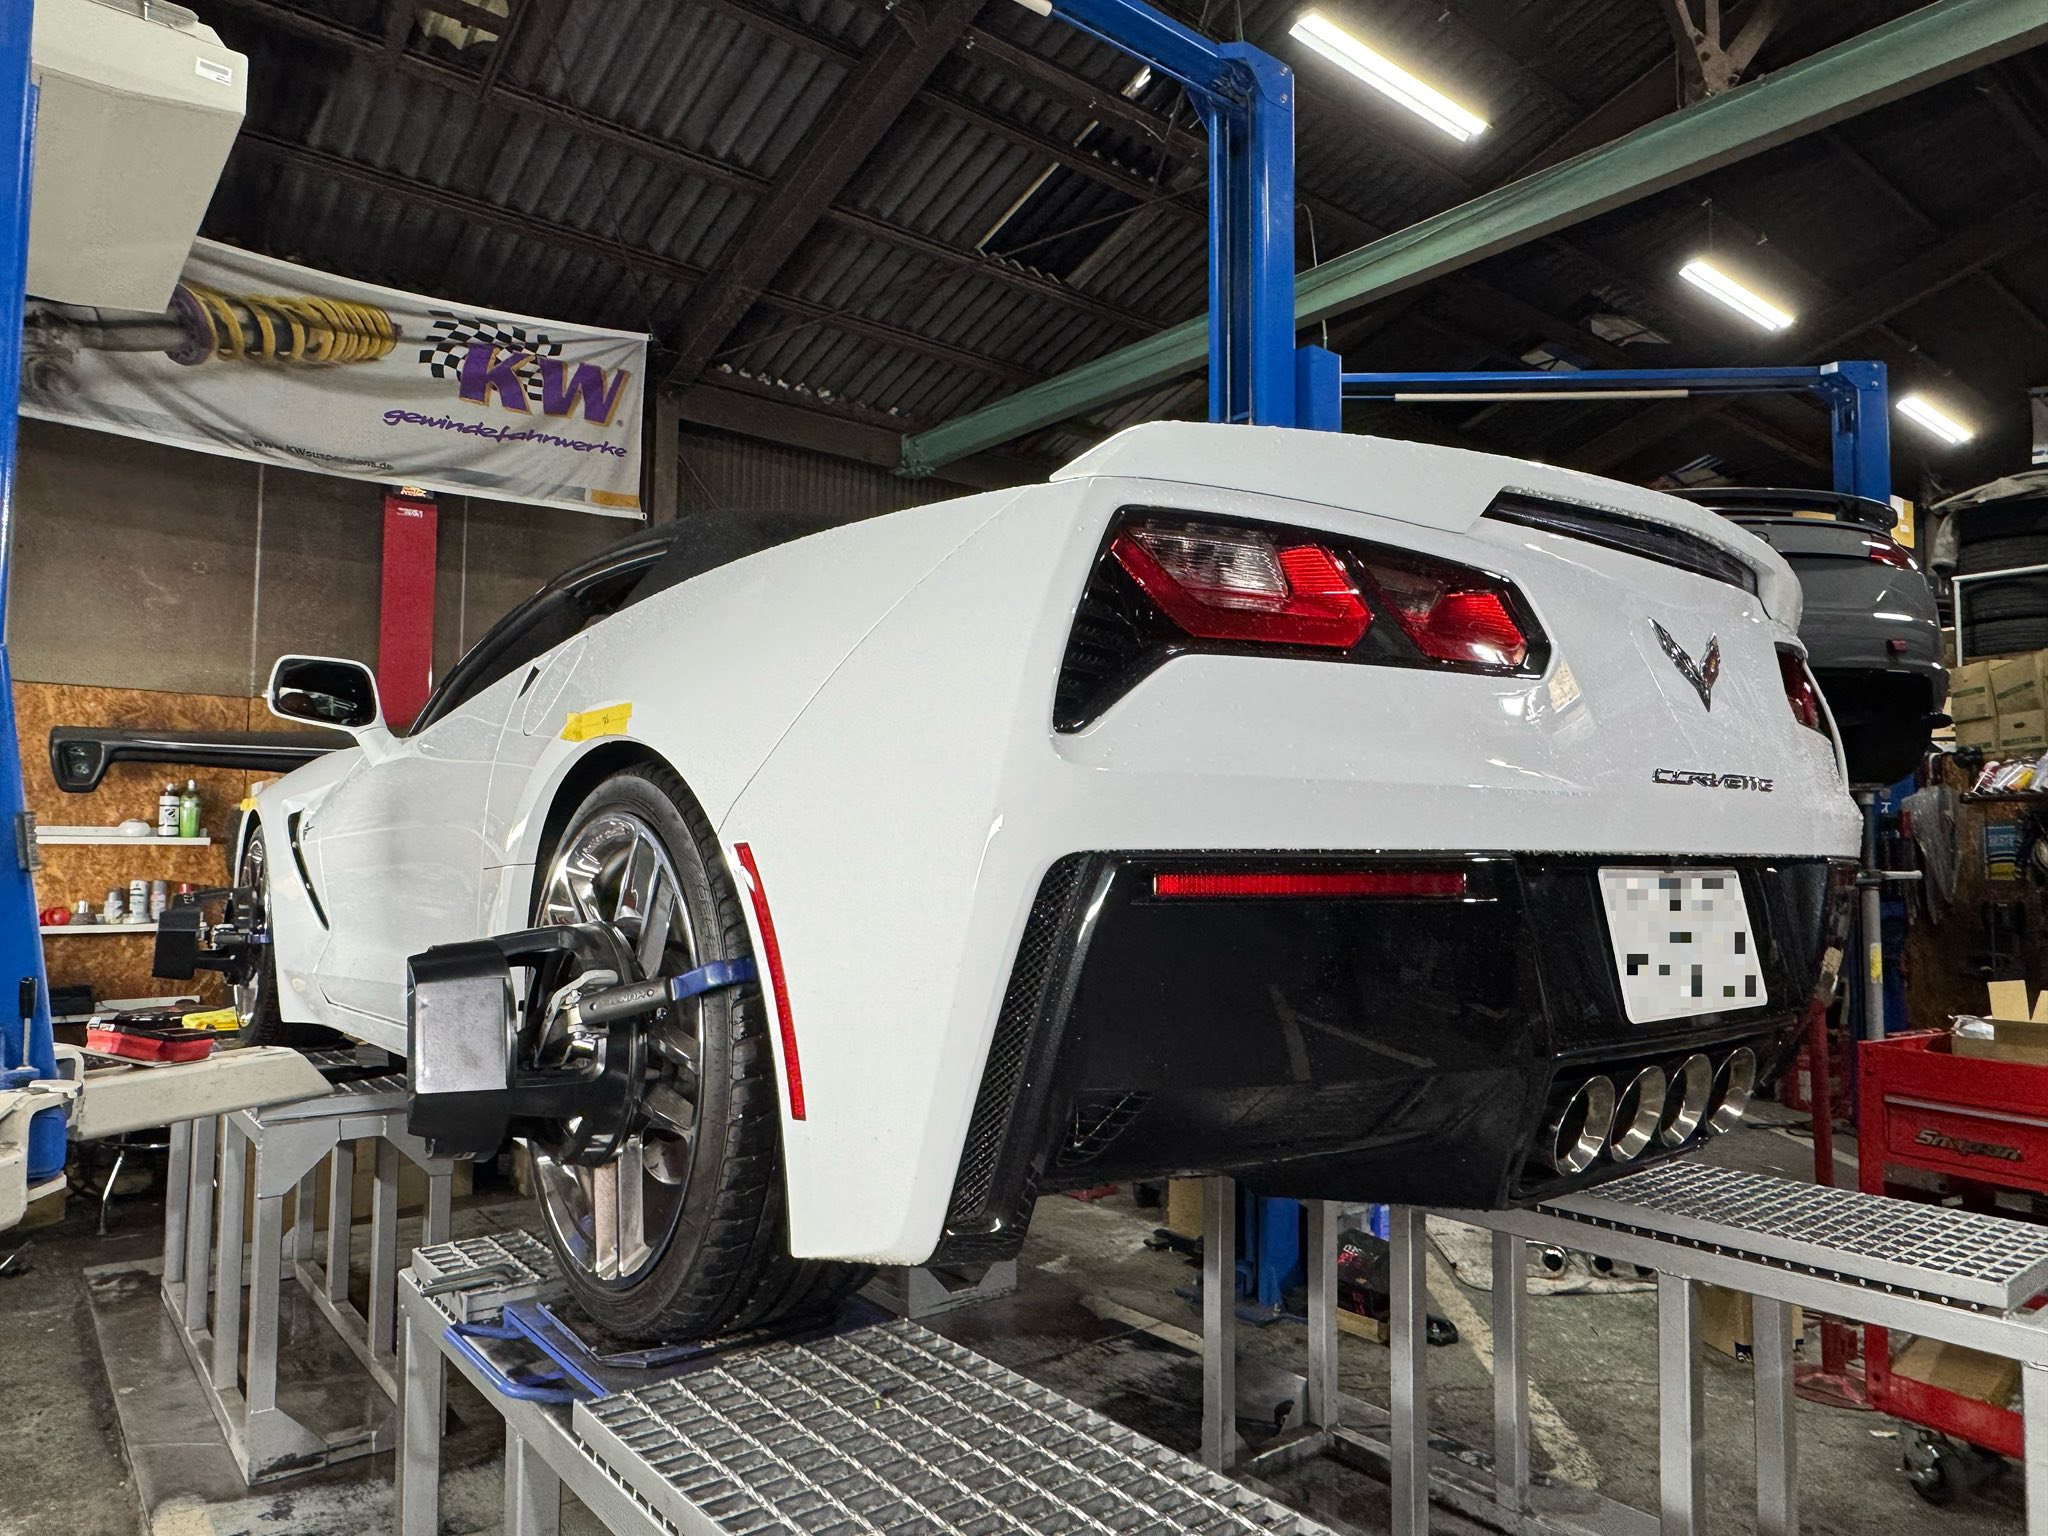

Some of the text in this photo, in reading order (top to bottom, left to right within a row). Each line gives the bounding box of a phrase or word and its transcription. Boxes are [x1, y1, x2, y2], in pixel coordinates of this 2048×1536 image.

[459, 344, 631, 426] KW
[383, 409, 627, 458] gewindefahrwerke
[1913, 1128, 2023, 1161] Snapon
